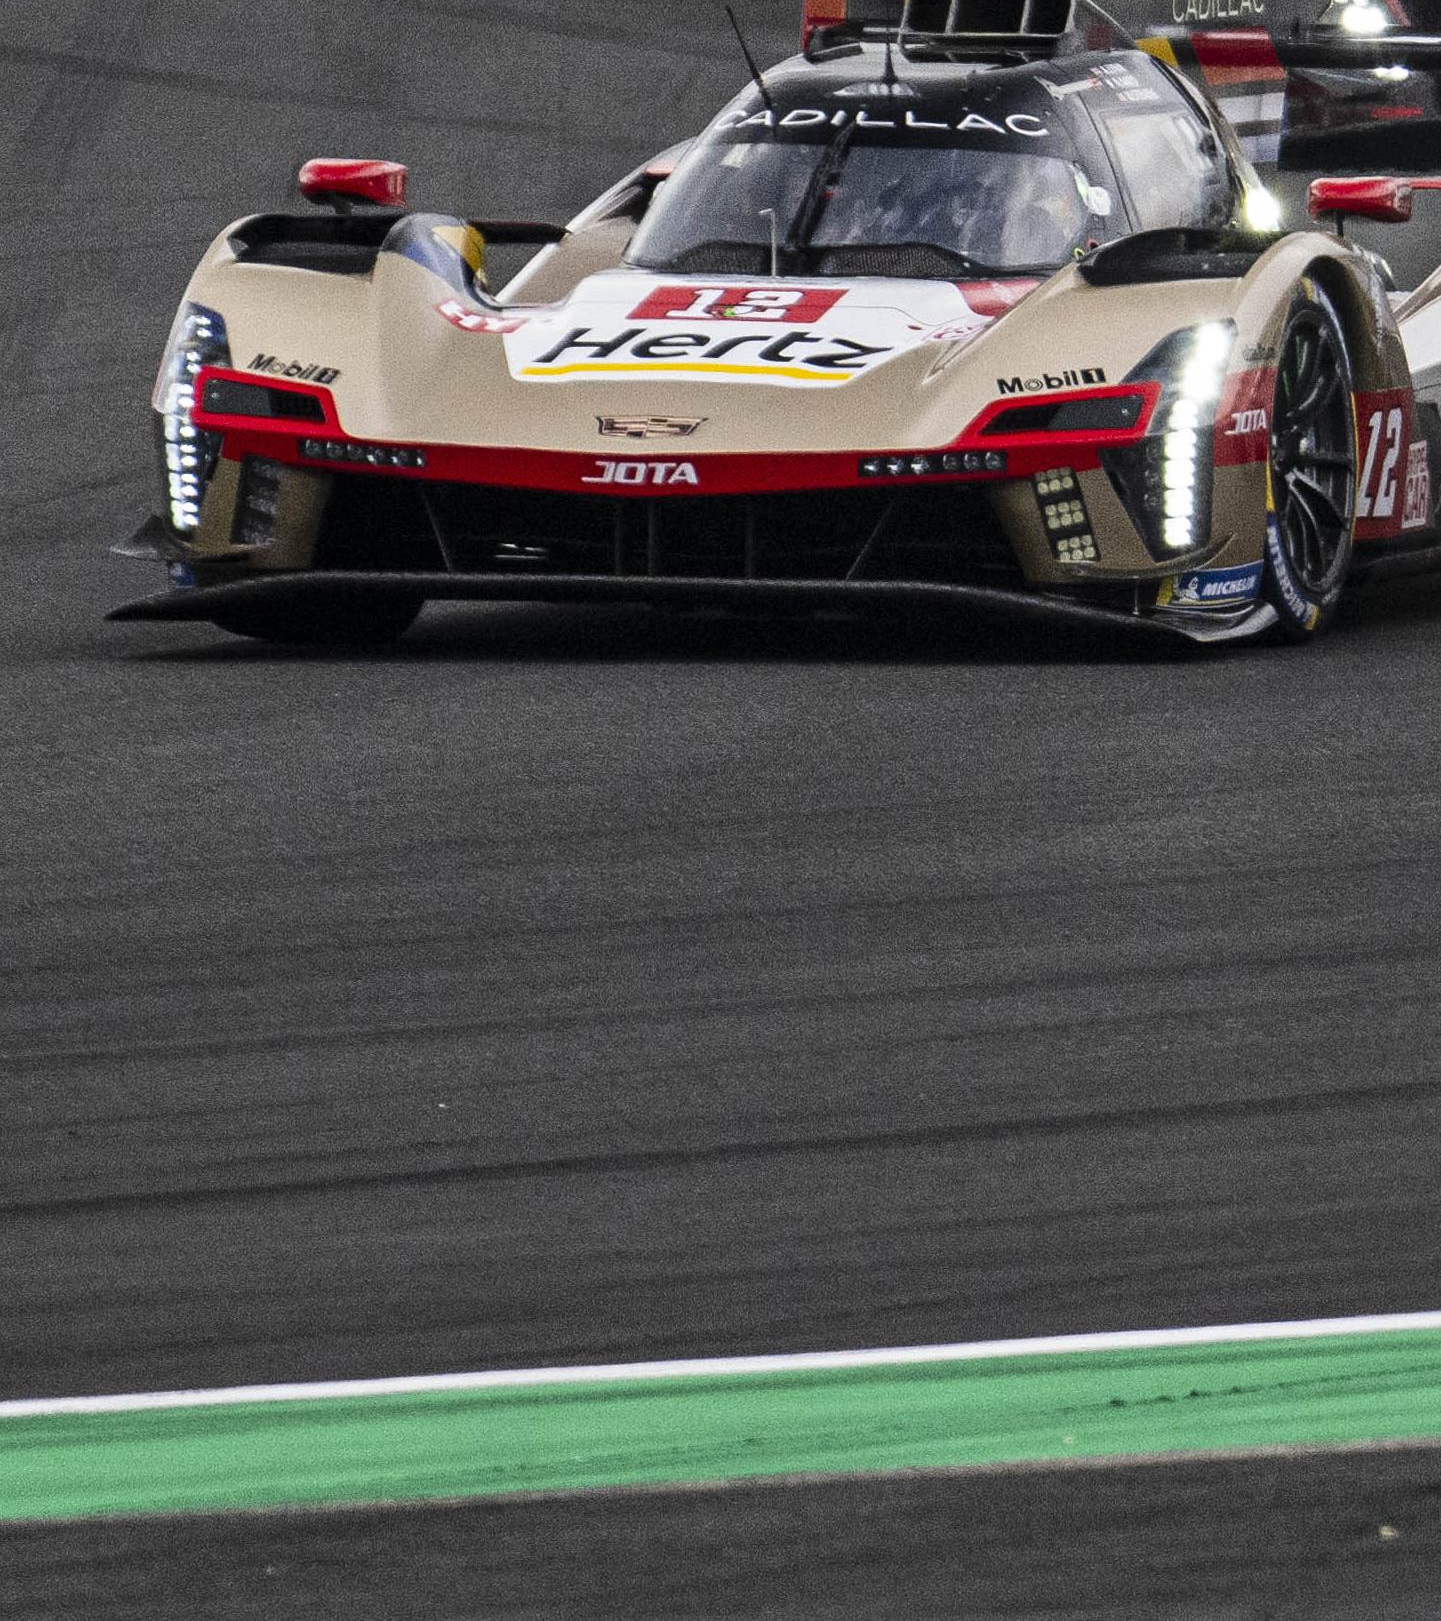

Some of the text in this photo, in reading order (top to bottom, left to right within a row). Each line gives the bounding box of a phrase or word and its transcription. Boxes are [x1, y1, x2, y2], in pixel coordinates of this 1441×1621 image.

[713, 108, 1050, 138] CADILLAC
[664, 287, 806, 320] 12
[532, 327, 895, 370] Hertz
[248, 352, 316, 383] Mobil
[996, 369, 1080, 396] Mobil
[1224, 409, 1267, 435] JOTA
[582, 459, 699, 487] JOTA
[1355, 407, 1404, 518] 12
